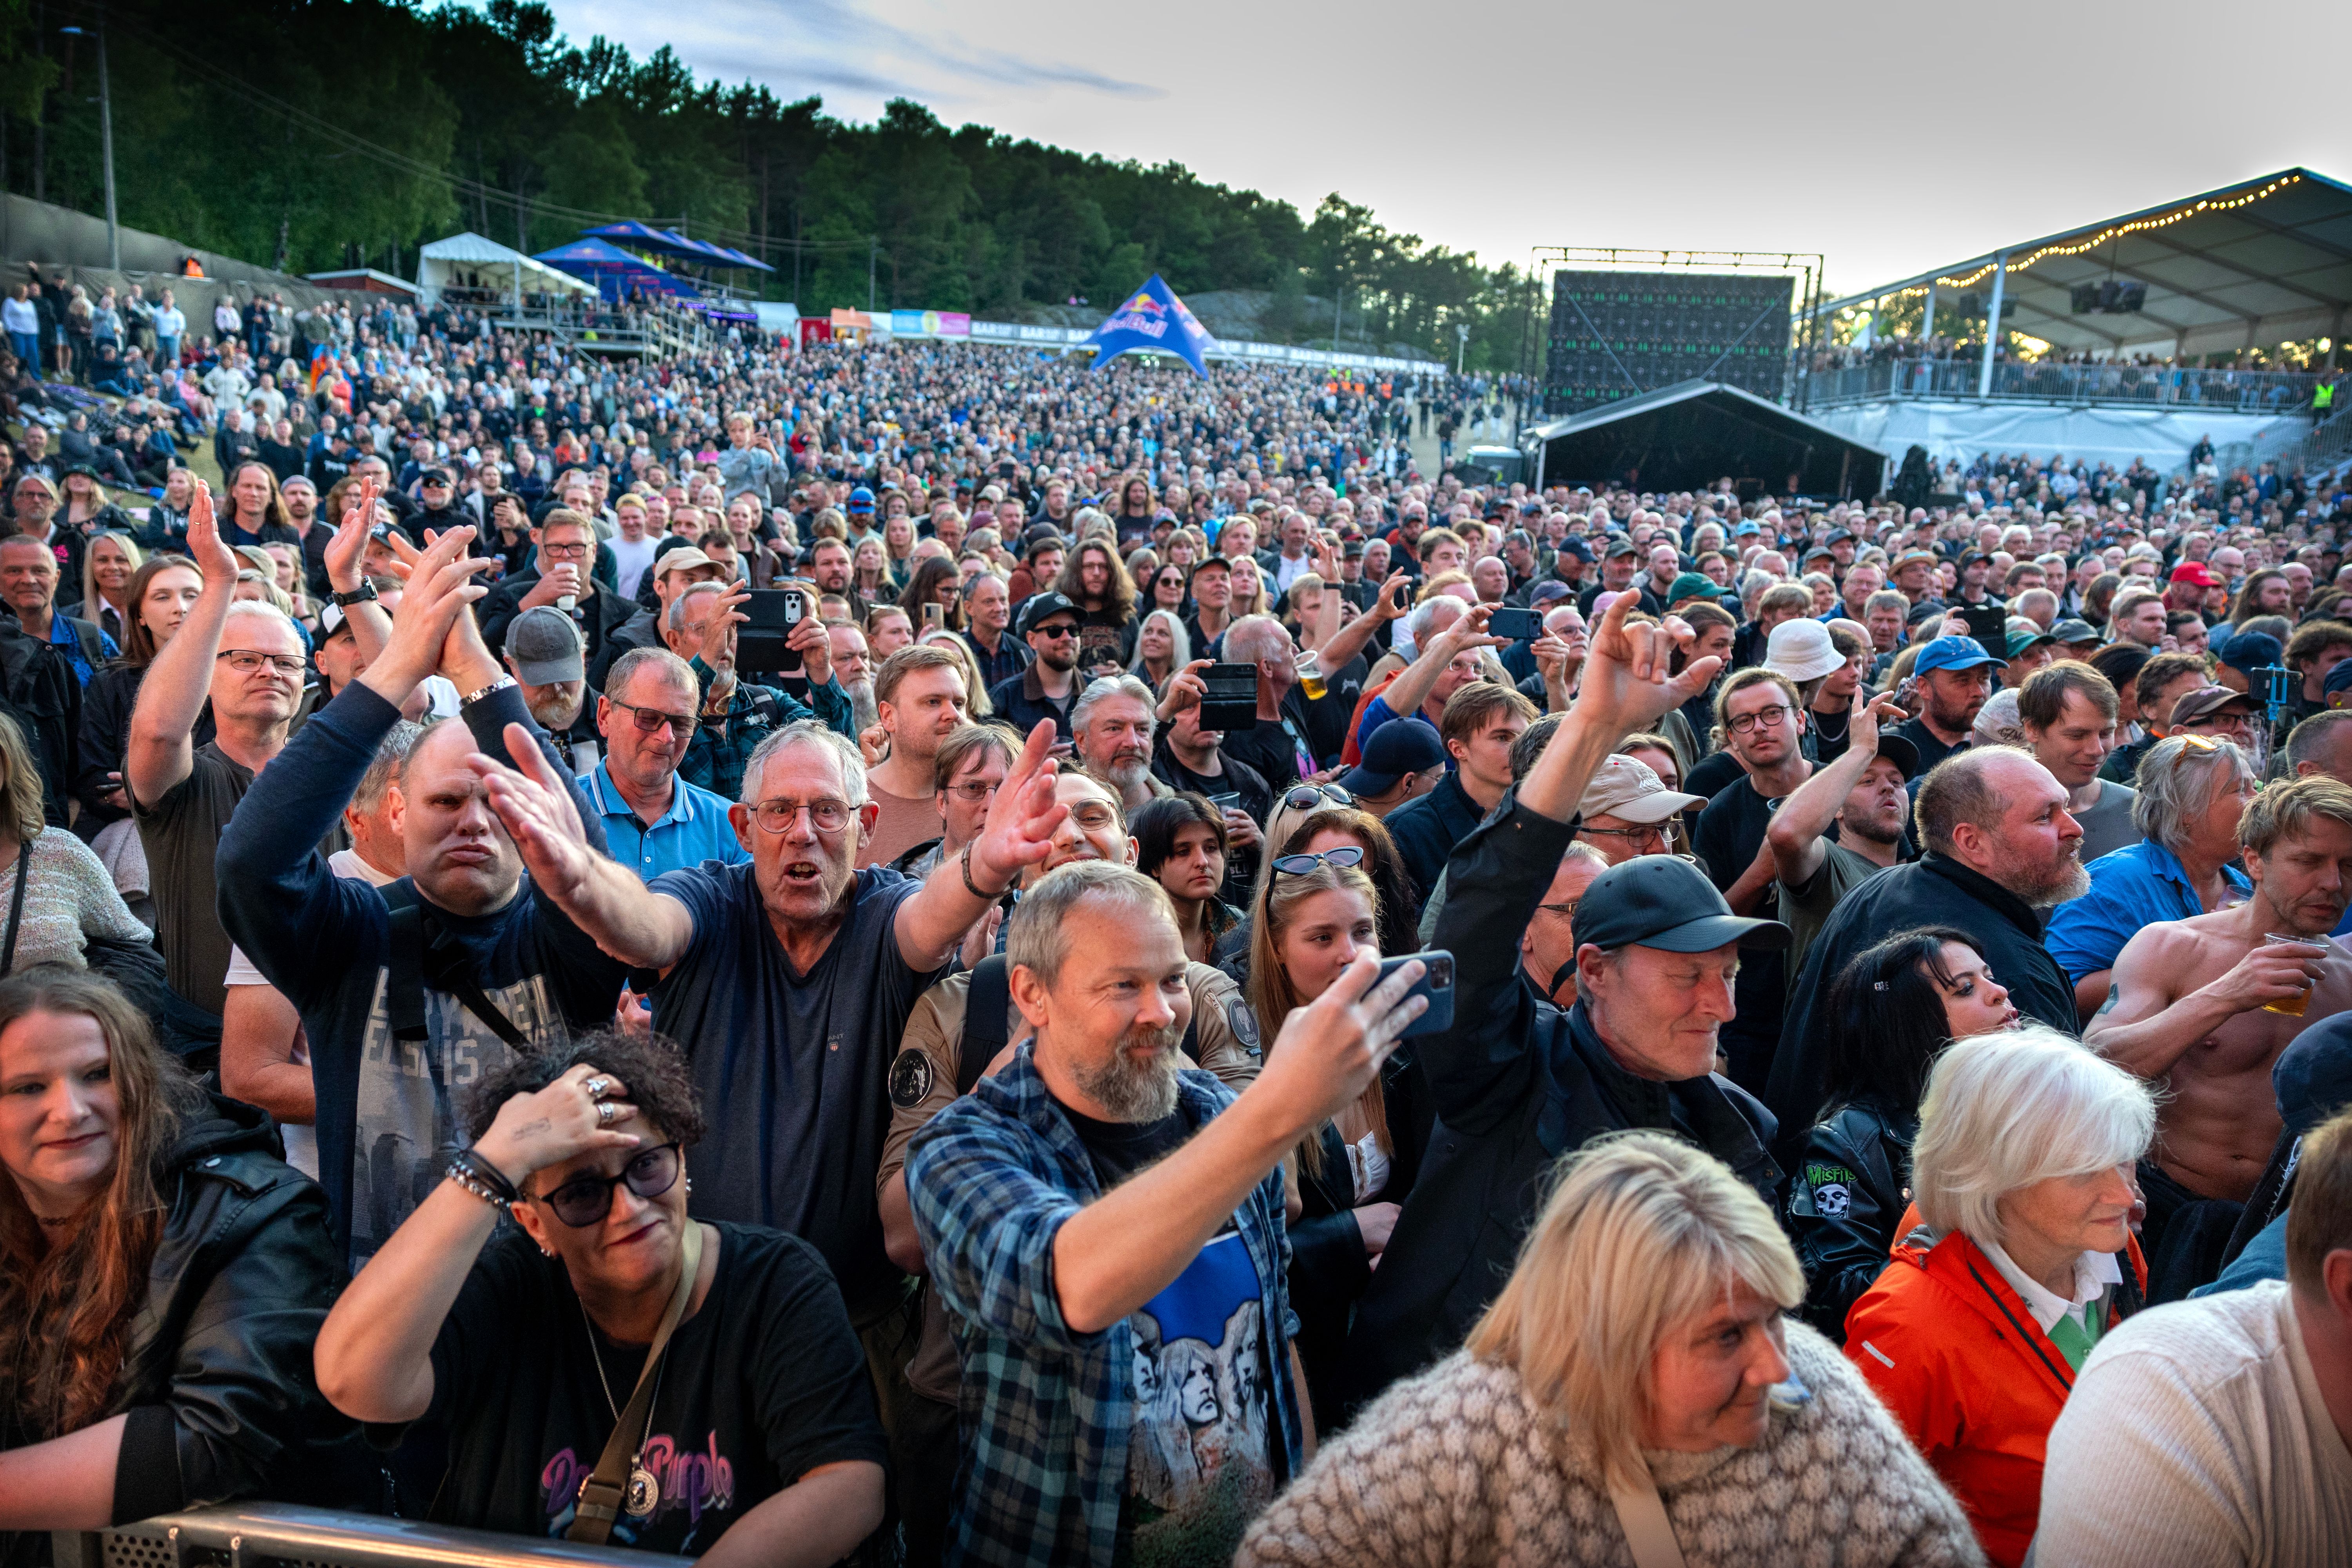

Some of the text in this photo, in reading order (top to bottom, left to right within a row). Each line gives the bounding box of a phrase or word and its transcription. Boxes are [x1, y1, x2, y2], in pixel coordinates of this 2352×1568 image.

[971, 322, 996, 334] BAR
[1020, 326, 1045, 339] BAR
[1128, 313, 1169, 339] Bull
[1639, 777, 1661, 789] MUST
[1244, 1032, 1257, 1042] BÖRÜ
[443, 1039, 479, 1086] IS
[643, 1429, 734, 1524] Purple
